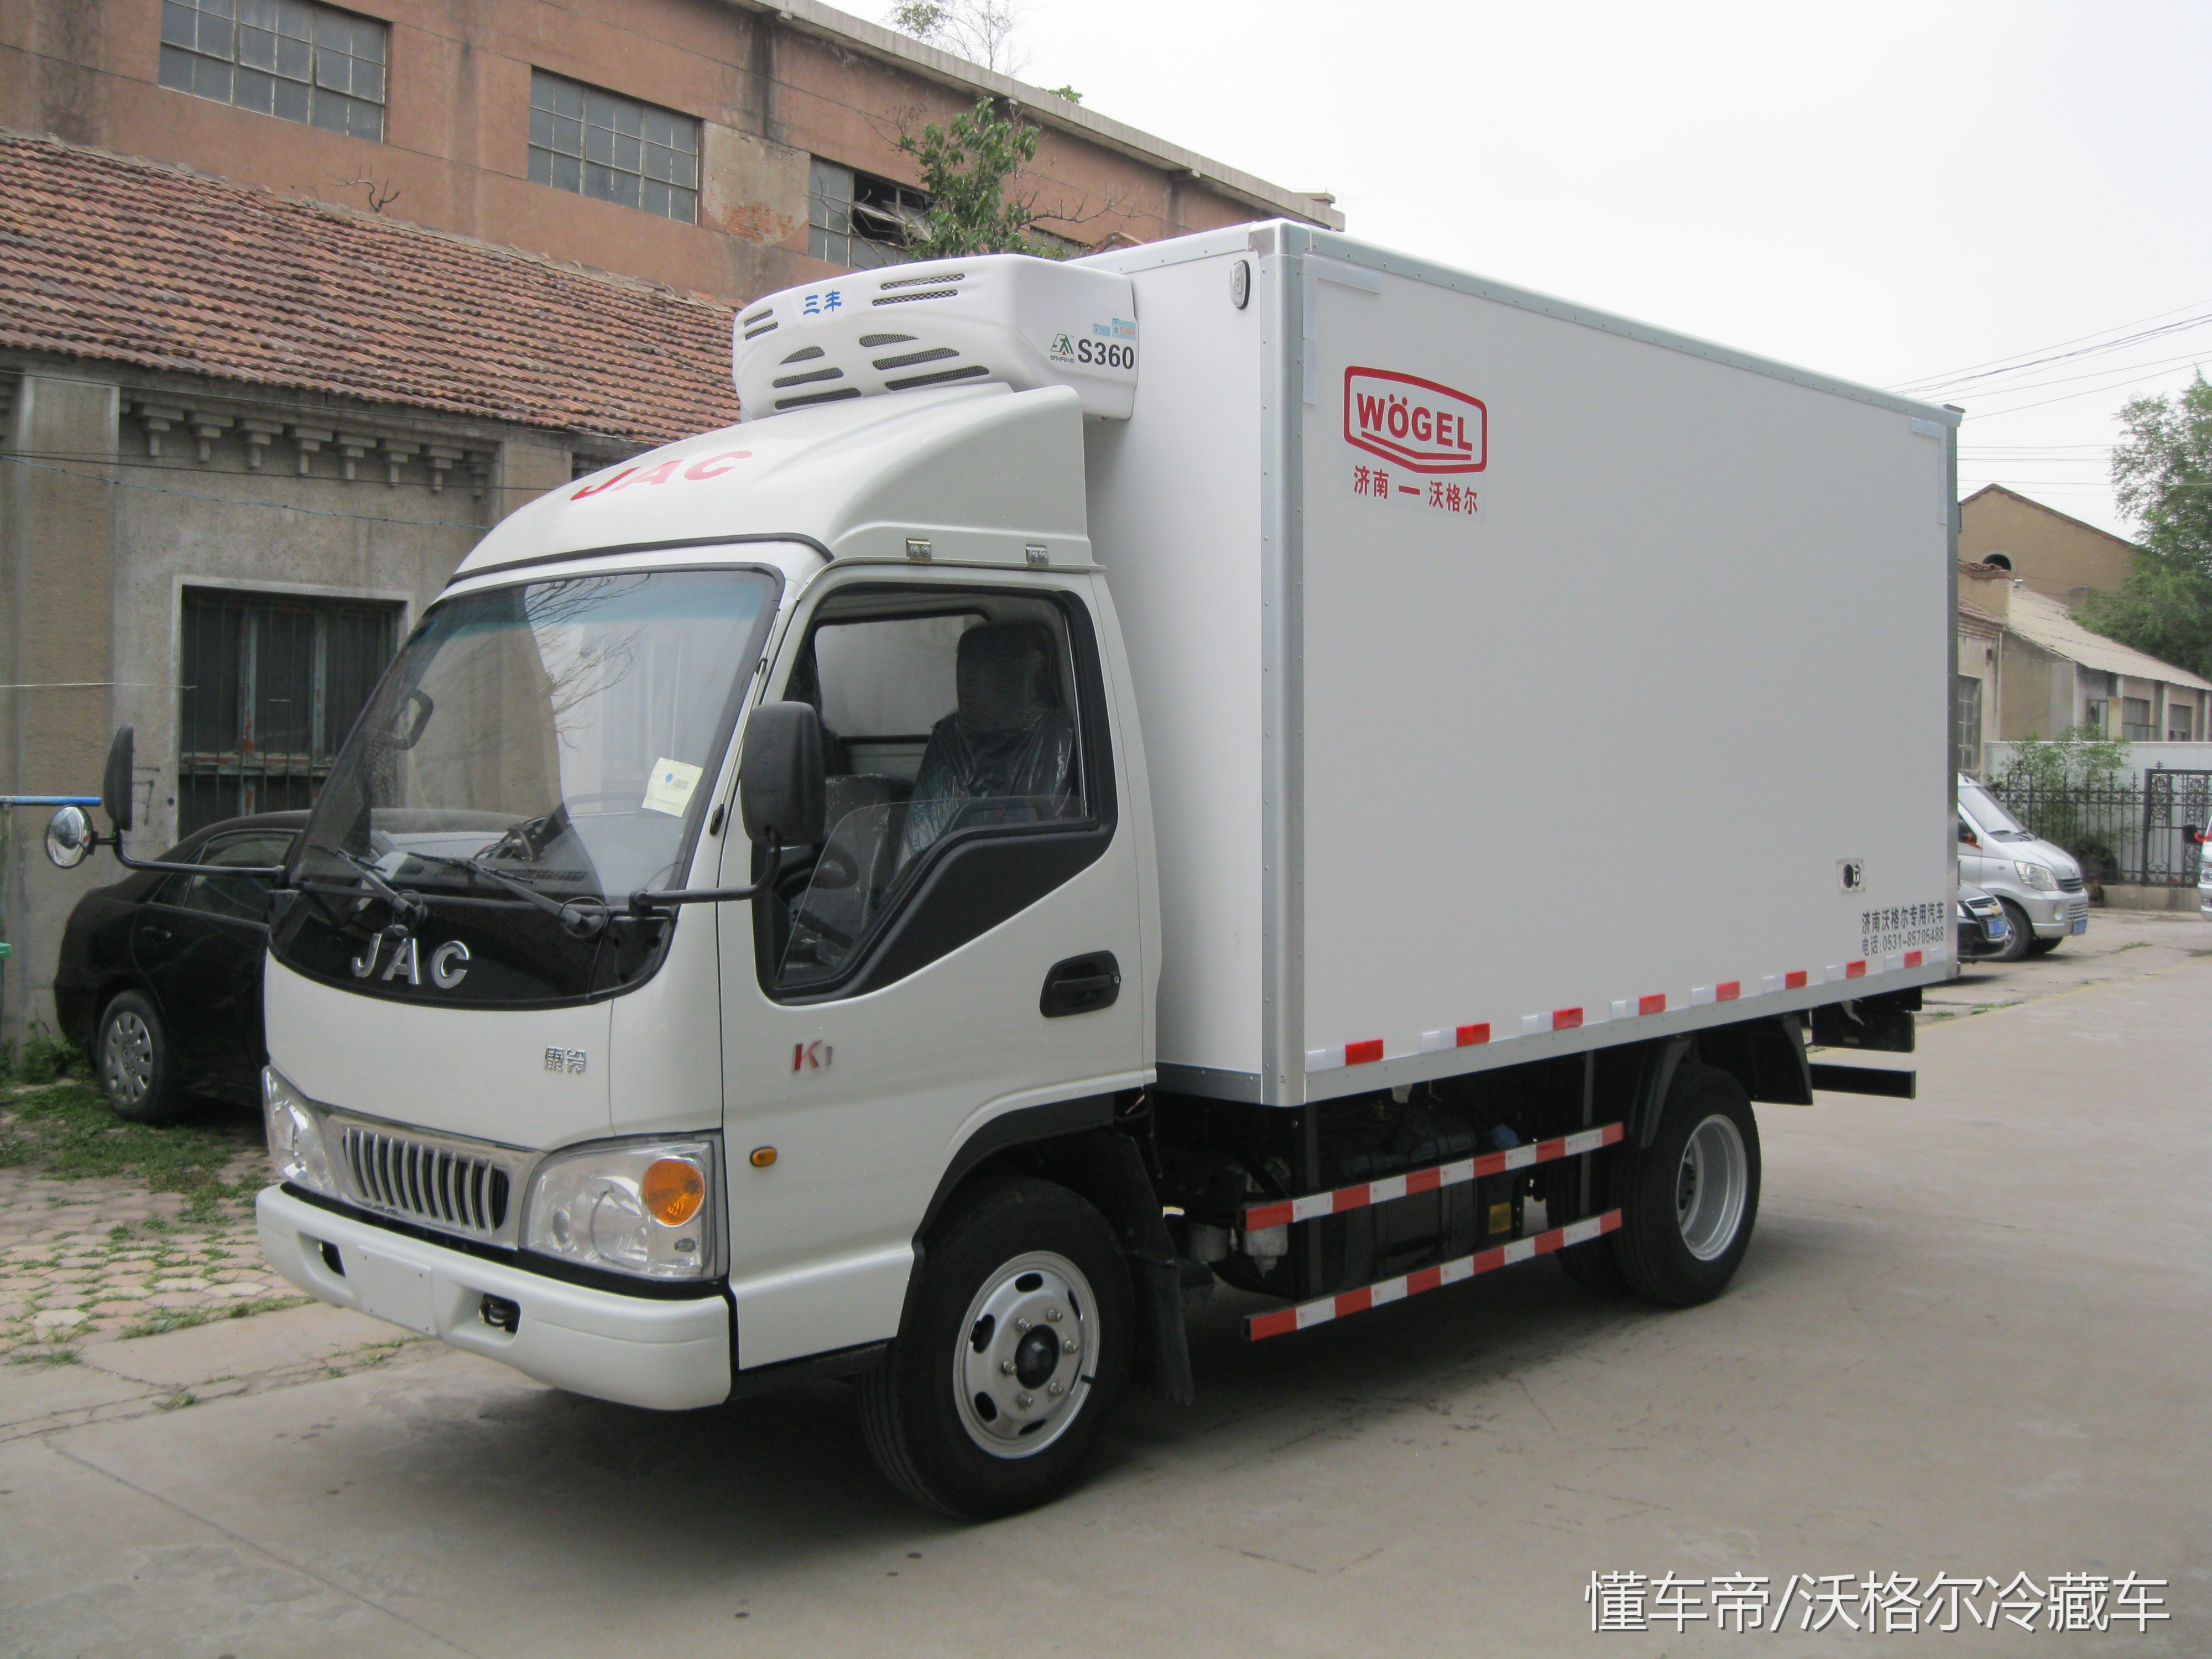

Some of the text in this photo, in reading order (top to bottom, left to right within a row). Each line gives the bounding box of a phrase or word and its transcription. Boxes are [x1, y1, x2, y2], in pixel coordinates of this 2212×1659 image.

[803, 289, 842, 315] 三丰
[1078, 338, 1134, 369] S360
[1356, 392, 1473, 451] WÖGEL
[570, 450, 753, 501] JAC
[1861, 901, 1944, 935] 济南沃格尔专用汽车
[351, 933, 469, 989] JAC
